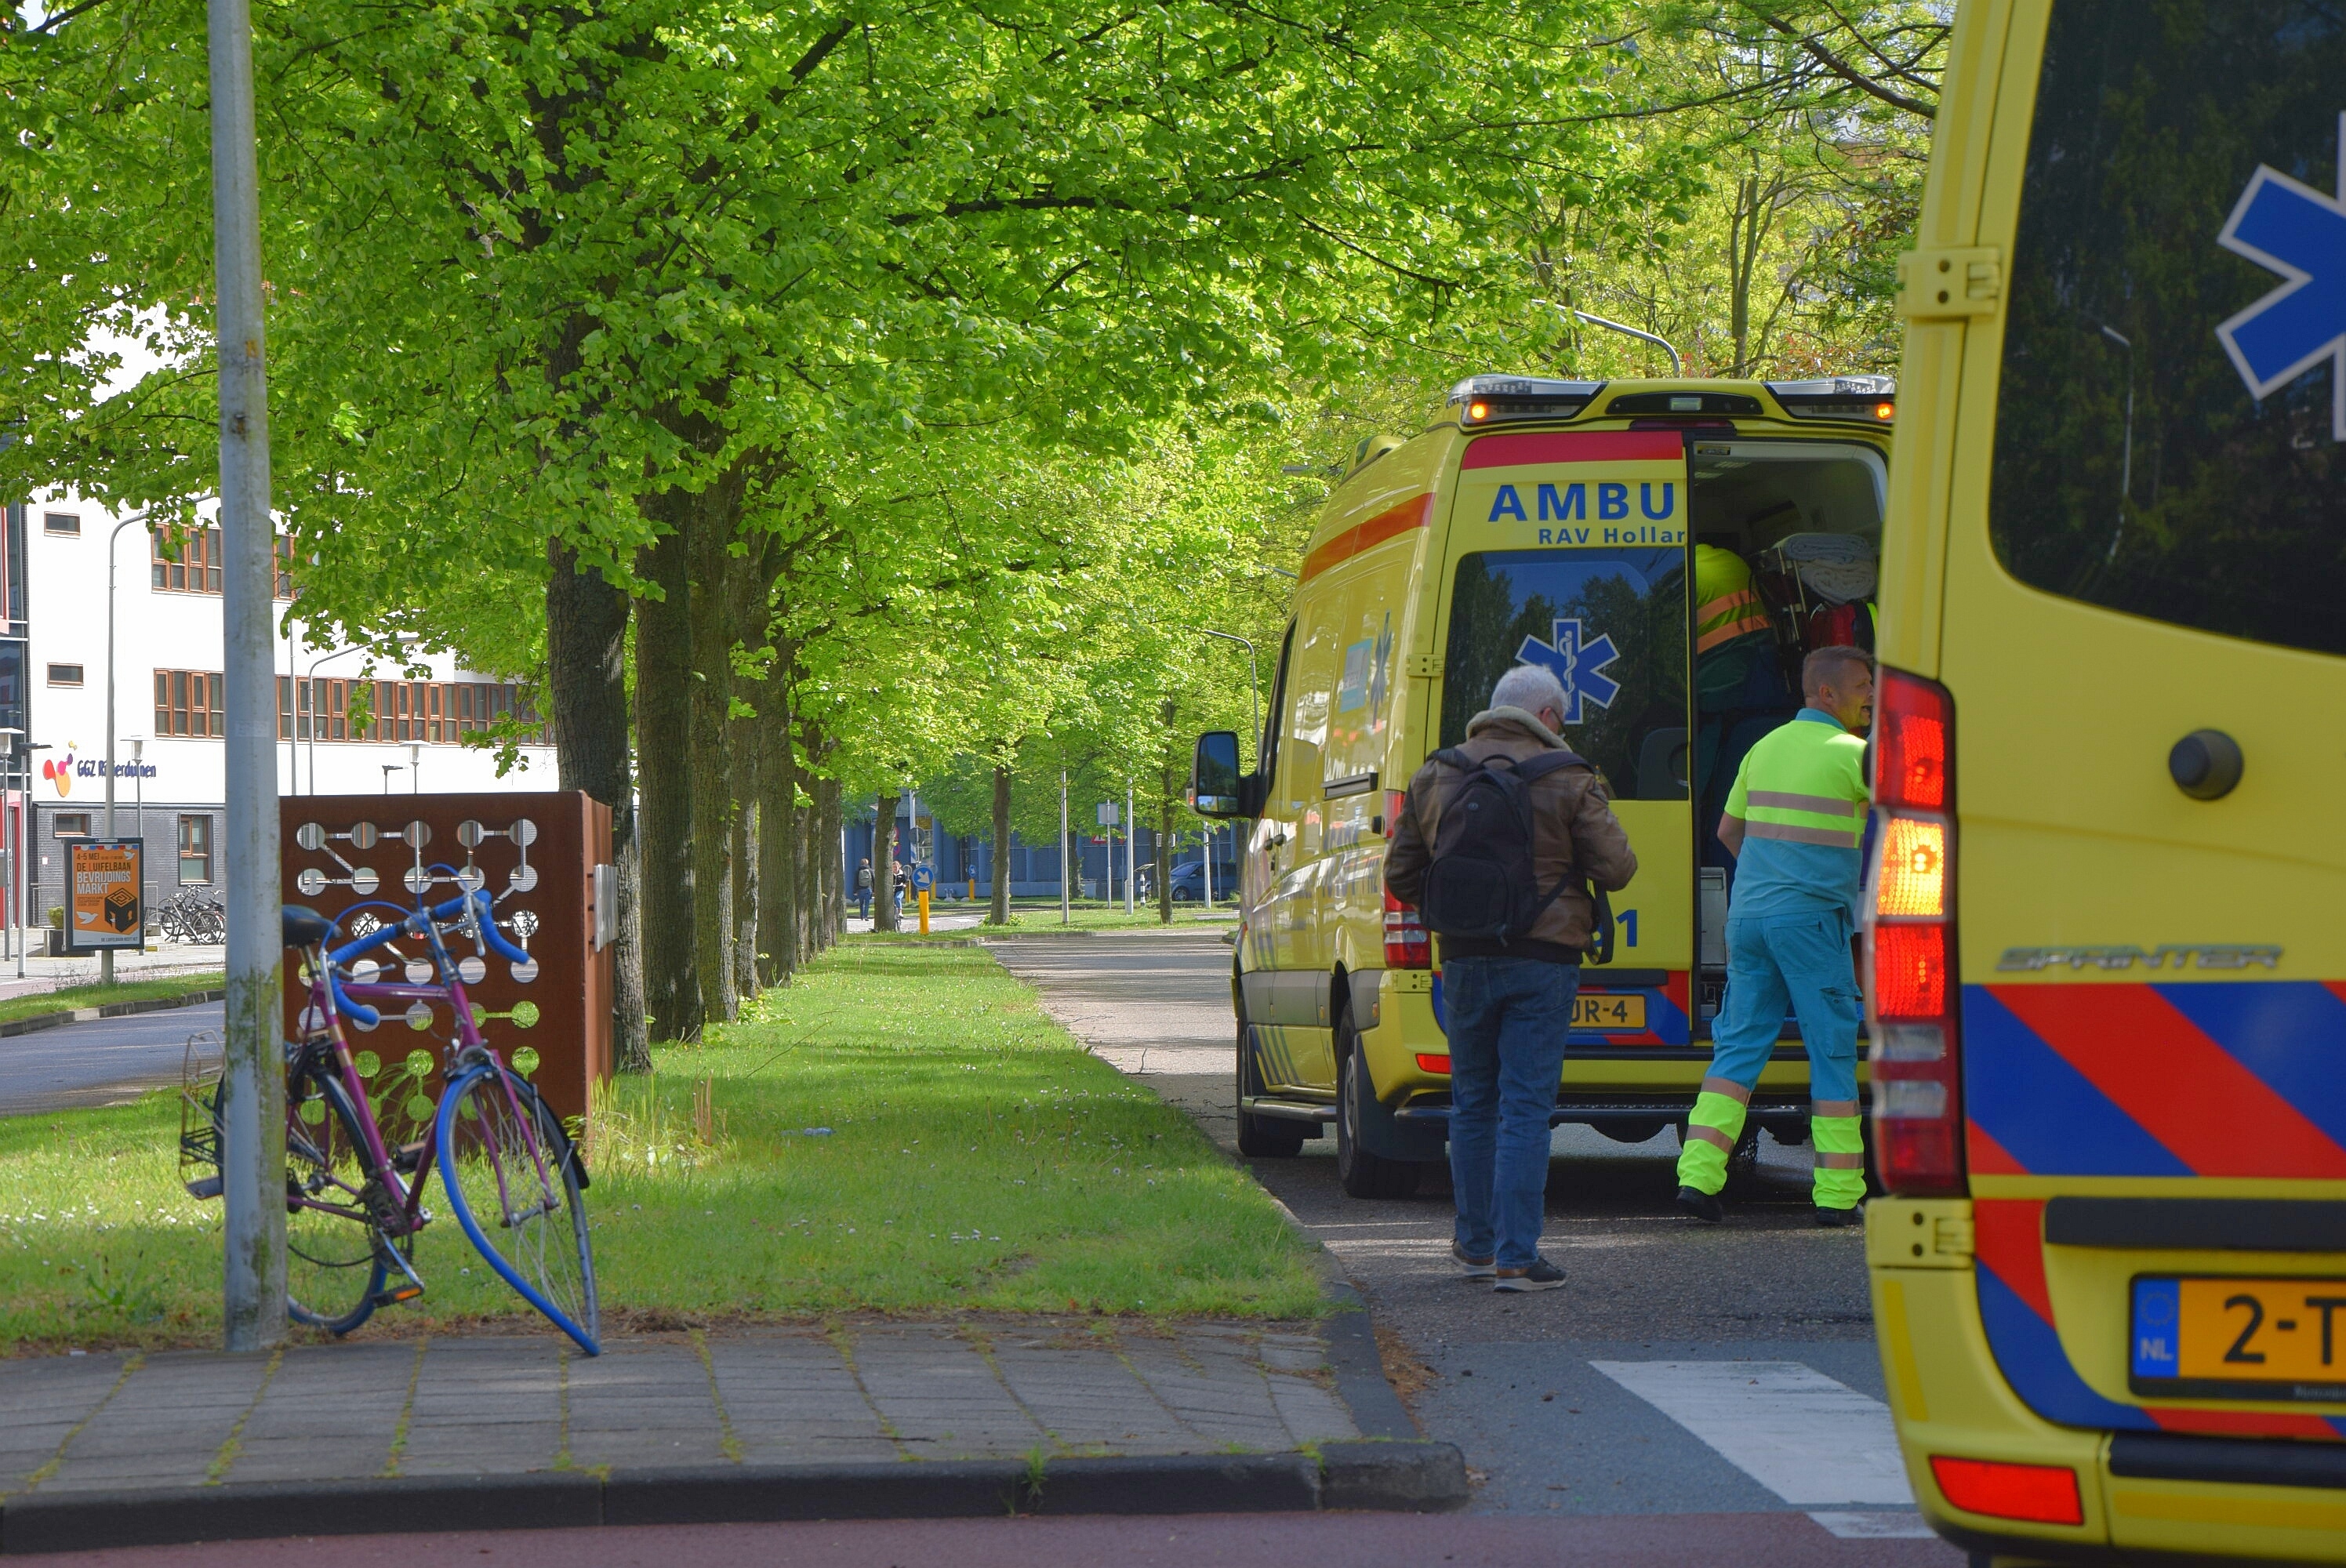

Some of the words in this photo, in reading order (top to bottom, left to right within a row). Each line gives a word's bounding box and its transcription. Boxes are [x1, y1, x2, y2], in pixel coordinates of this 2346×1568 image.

[1487, 482, 1674, 522] AMBU
[1538, 527, 1591, 544] RAV
[77, 759, 96, 778] GGZ
[89, 852, 100, 861] MEI
[77, 862, 86, 871] DE
[89, 862, 131, 871] LUIFELBAAN
[77, 871, 131, 883] BEVRIJDINGS
[77, 883, 109, 895] MARKT
[1994, 943, 2283, 971] SPRINTER
[2222, 1294, 2346, 1366] 2-T
[2139, 1336, 2174, 1362] NL
